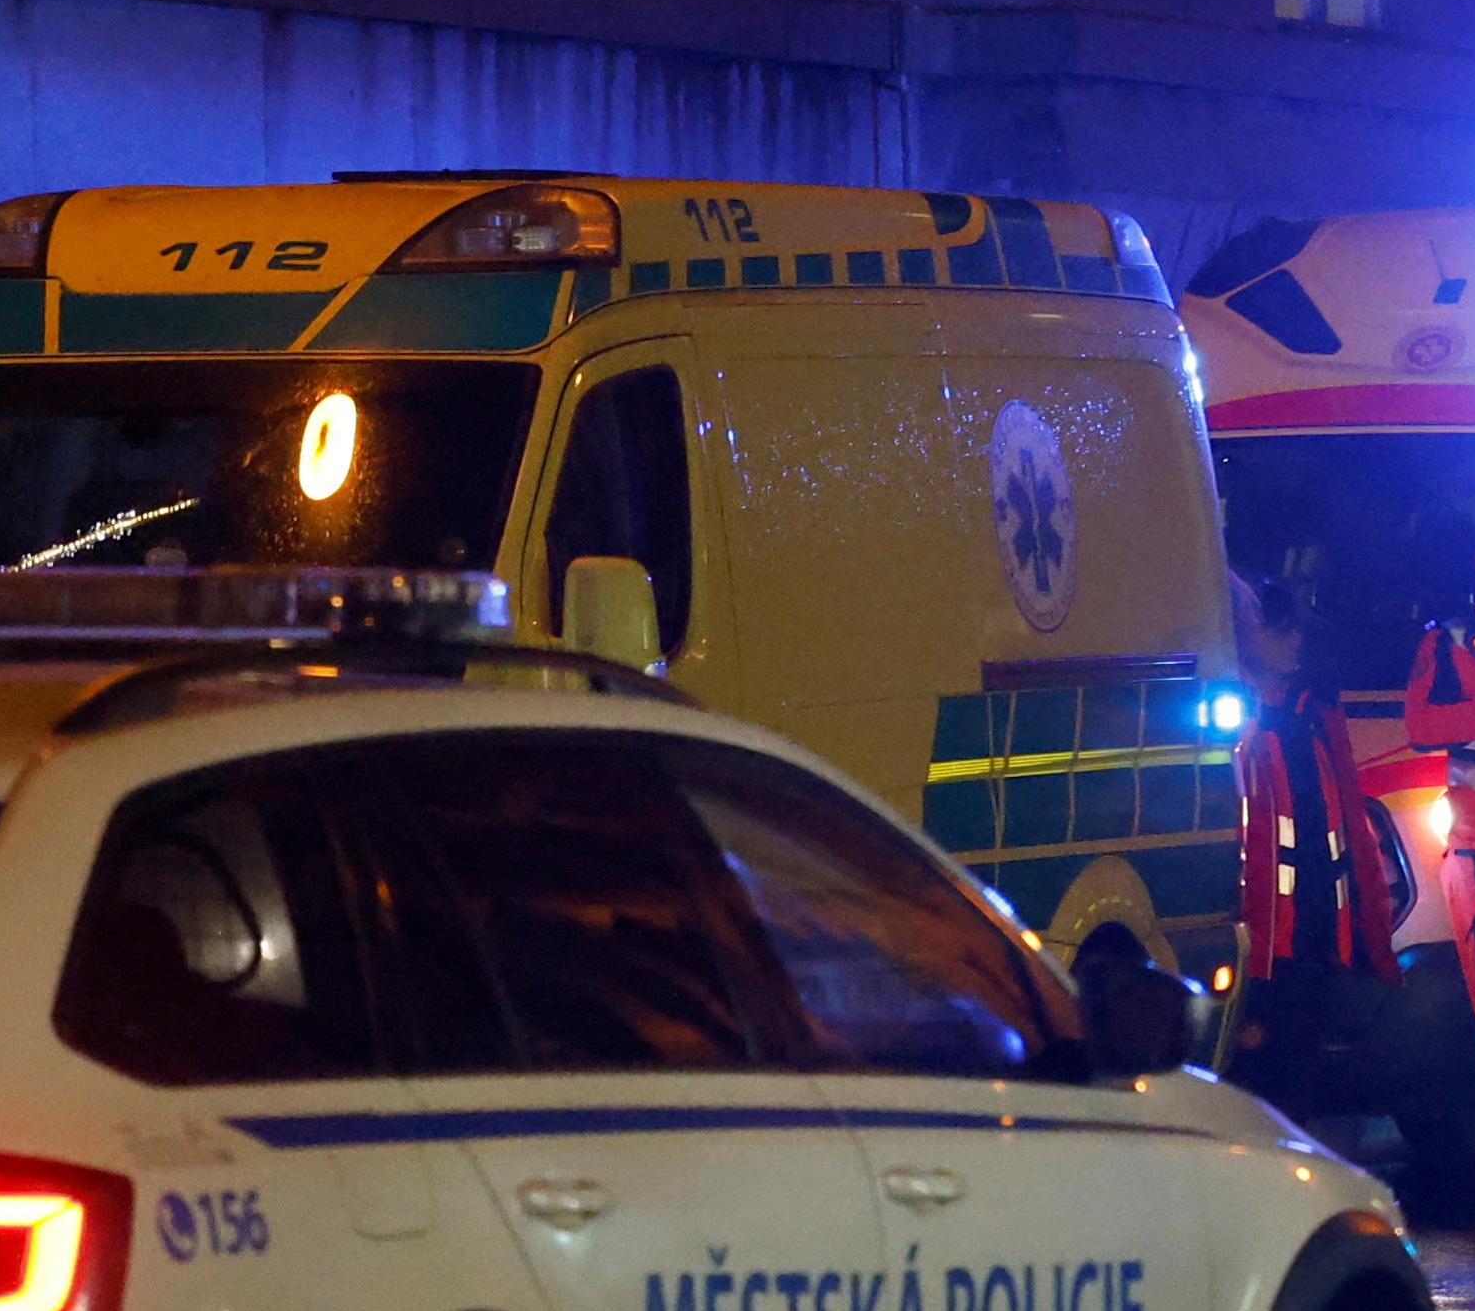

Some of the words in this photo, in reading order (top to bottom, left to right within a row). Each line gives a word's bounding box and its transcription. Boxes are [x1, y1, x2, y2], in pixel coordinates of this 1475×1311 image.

[684, 198, 760, 242] 112
[160, 241, 329, 272] 112
[198, 1190, 271, 1257] 156
